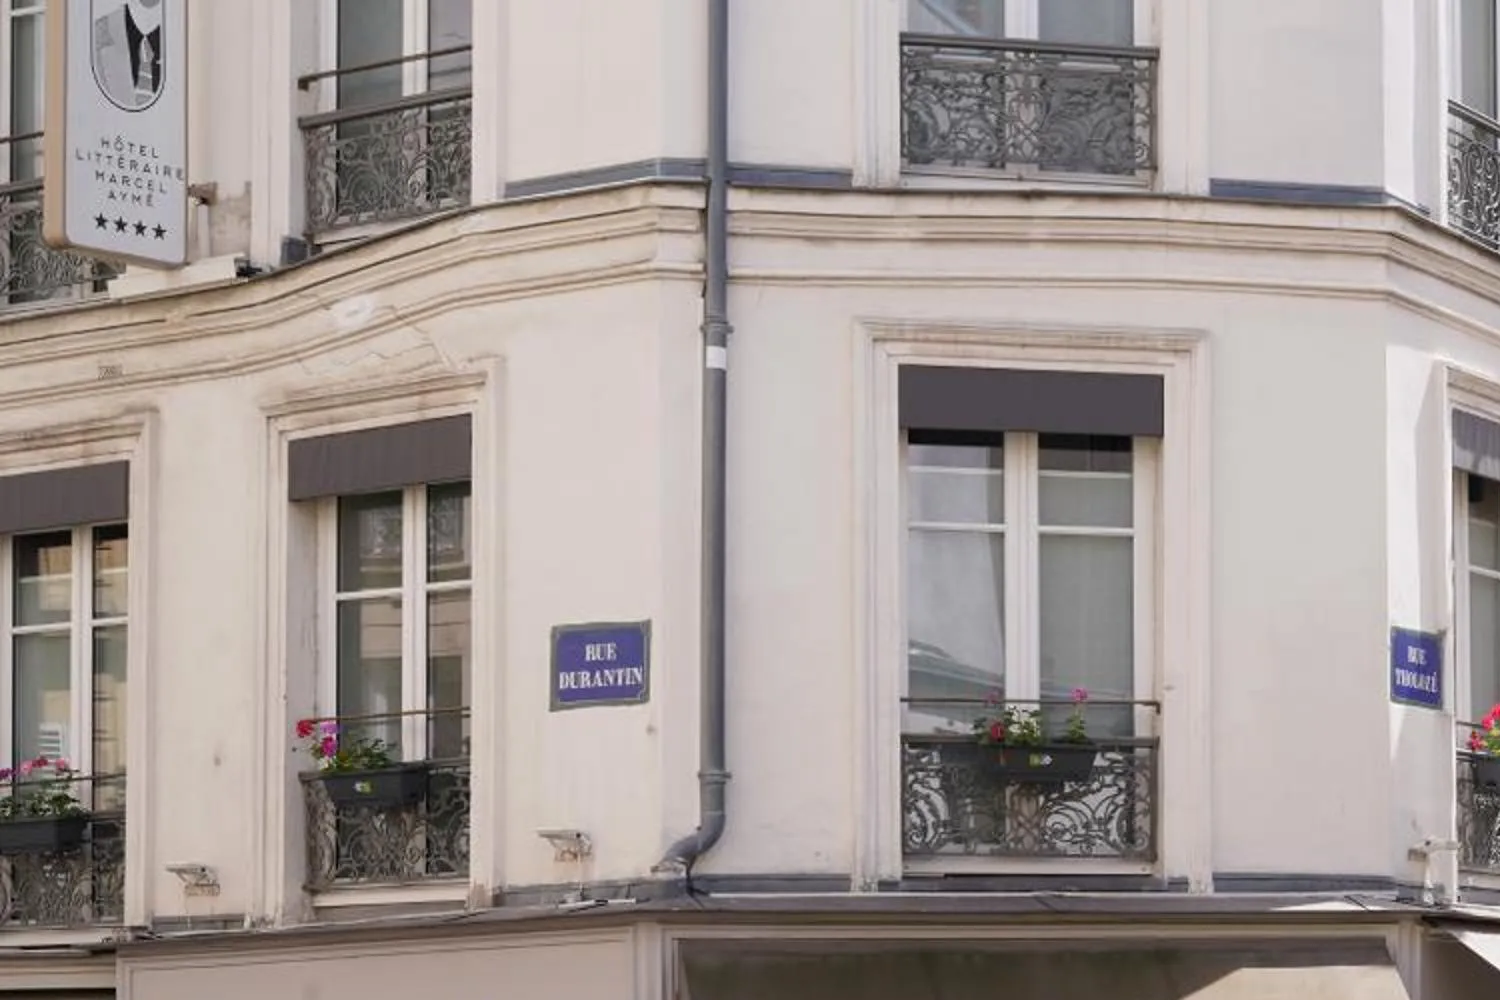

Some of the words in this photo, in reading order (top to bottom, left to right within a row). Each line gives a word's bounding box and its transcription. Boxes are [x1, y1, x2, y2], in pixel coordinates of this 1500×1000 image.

[101, 135, 159, 159] HÔTEL
[75, 147, 184, 181] LITTÉRAIRE
[95, 170, 167, 195] MARCEL
[585, 642, 617, 661] RUE
[1407, 645, 1427, 666] RUE
[559, 665, 643, 689] DURANTIN
